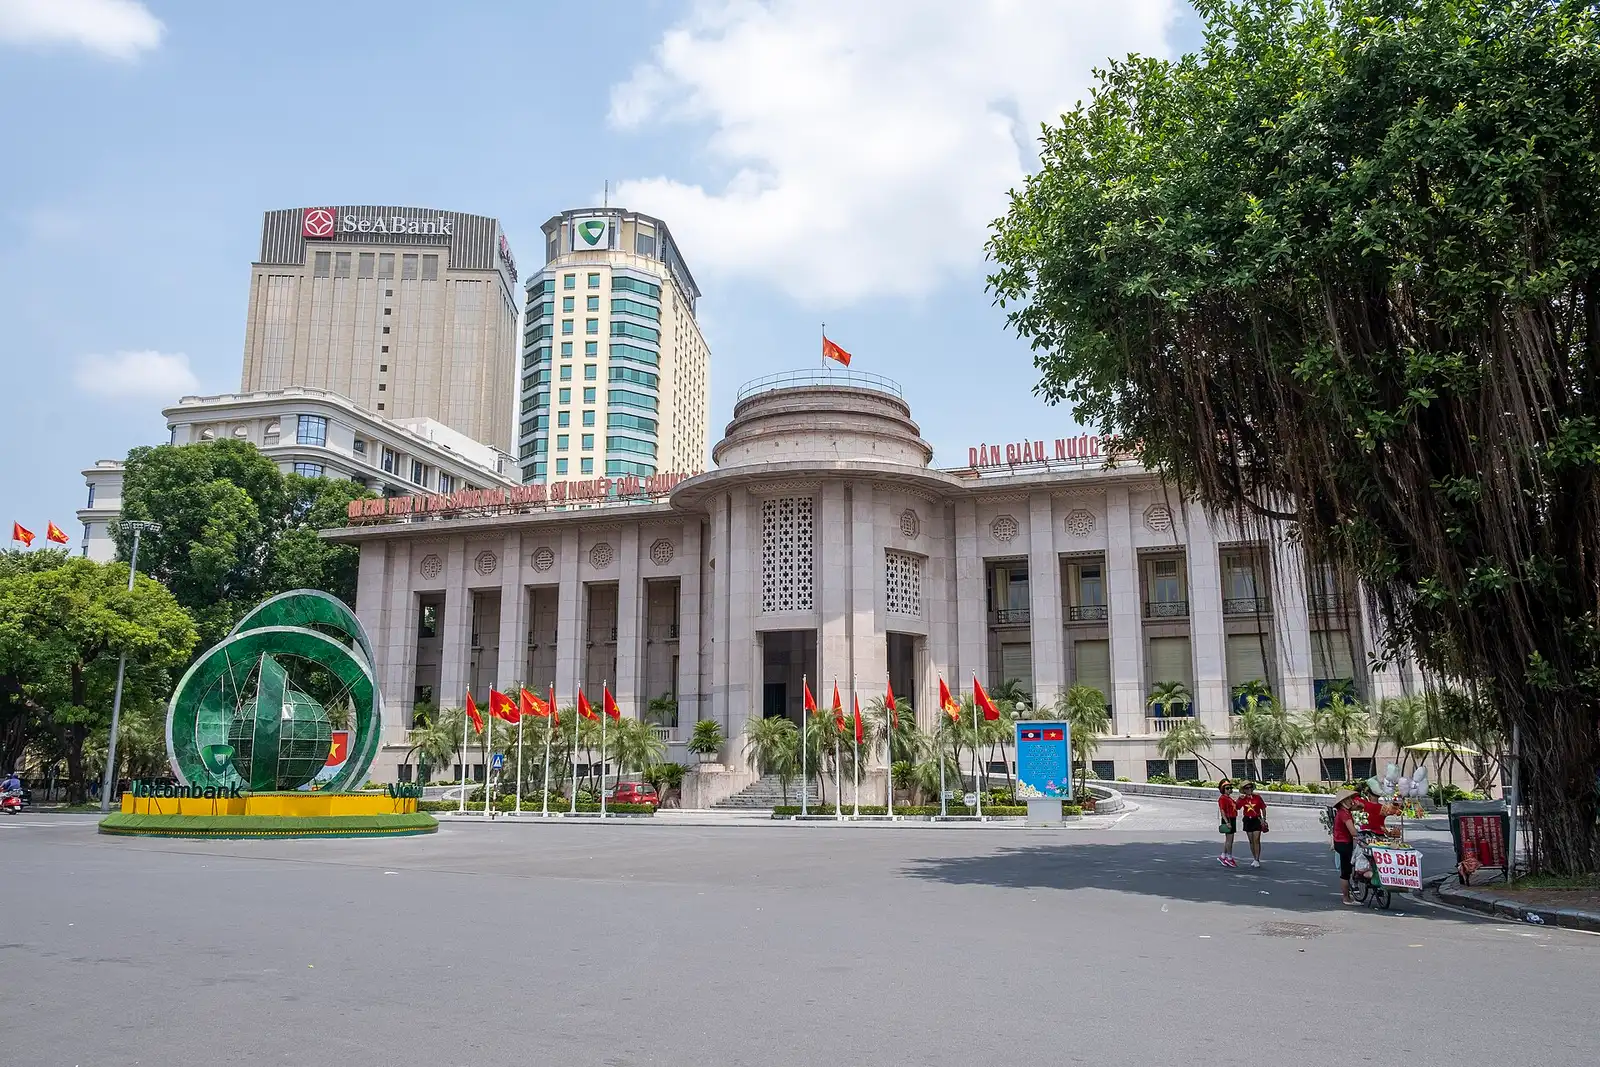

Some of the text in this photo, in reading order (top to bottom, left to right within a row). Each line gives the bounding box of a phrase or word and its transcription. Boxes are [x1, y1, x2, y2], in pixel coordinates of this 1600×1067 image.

[342, 214, 453, 236] SeABank
[968, 443, 1000, 467] DÂN
[1055, 432, 1099, 458] NƯỚC
[616, 471, 641, 496] CỦA
[1373, 850, 1418, 867] BÒ BÍA
[1398, 867, 1418, 877] XÍCH
